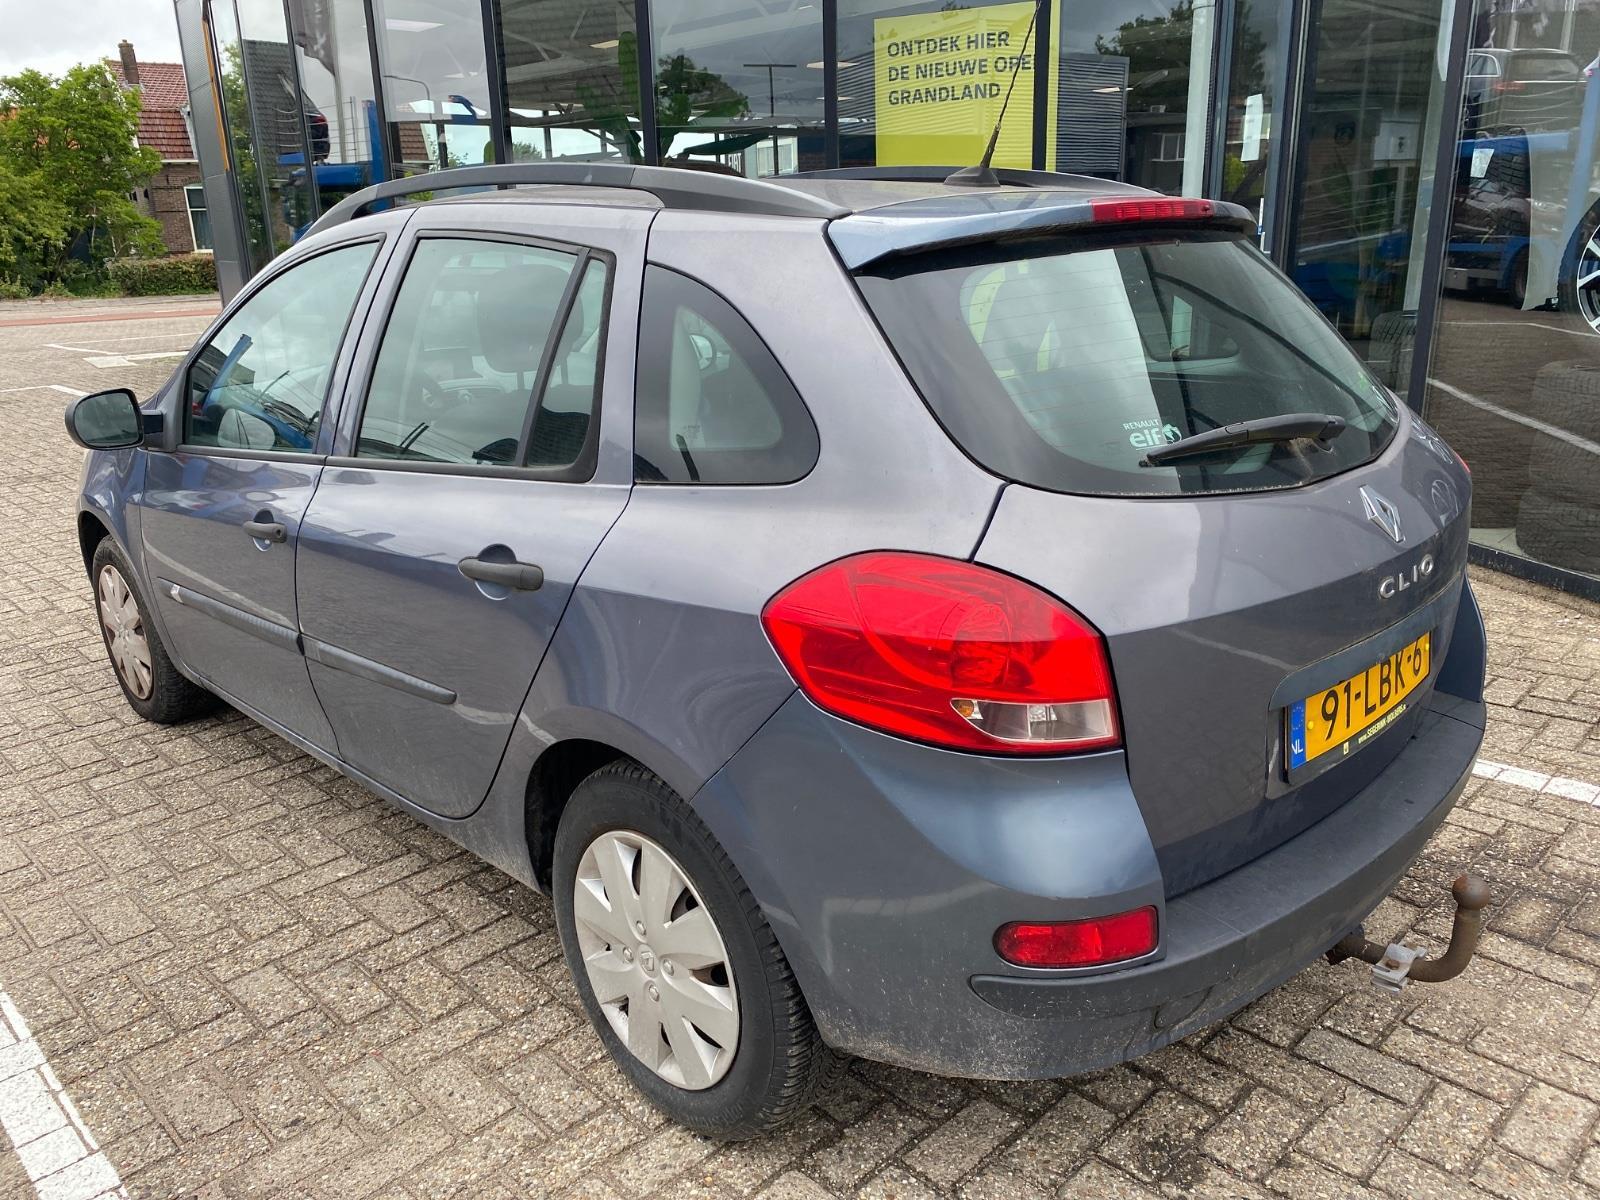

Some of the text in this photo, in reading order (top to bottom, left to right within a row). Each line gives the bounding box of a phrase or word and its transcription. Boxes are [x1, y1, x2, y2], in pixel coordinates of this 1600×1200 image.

[887, 31, 1010, 58] ONTDEK HIER
[888, 54, 1035, 82] DE NIEUWE OPE
[888, 82, 1001, 106] GRANDLAND
[728, 152, 742, 174] FIAT
[1122, 419, 1160, 431] RENAULT
[1129, 427, 1161, 448] elf
[1380, 553, 1434, 599] CLIO
[1321, 640, 1422, 741] 91-LBK-6
